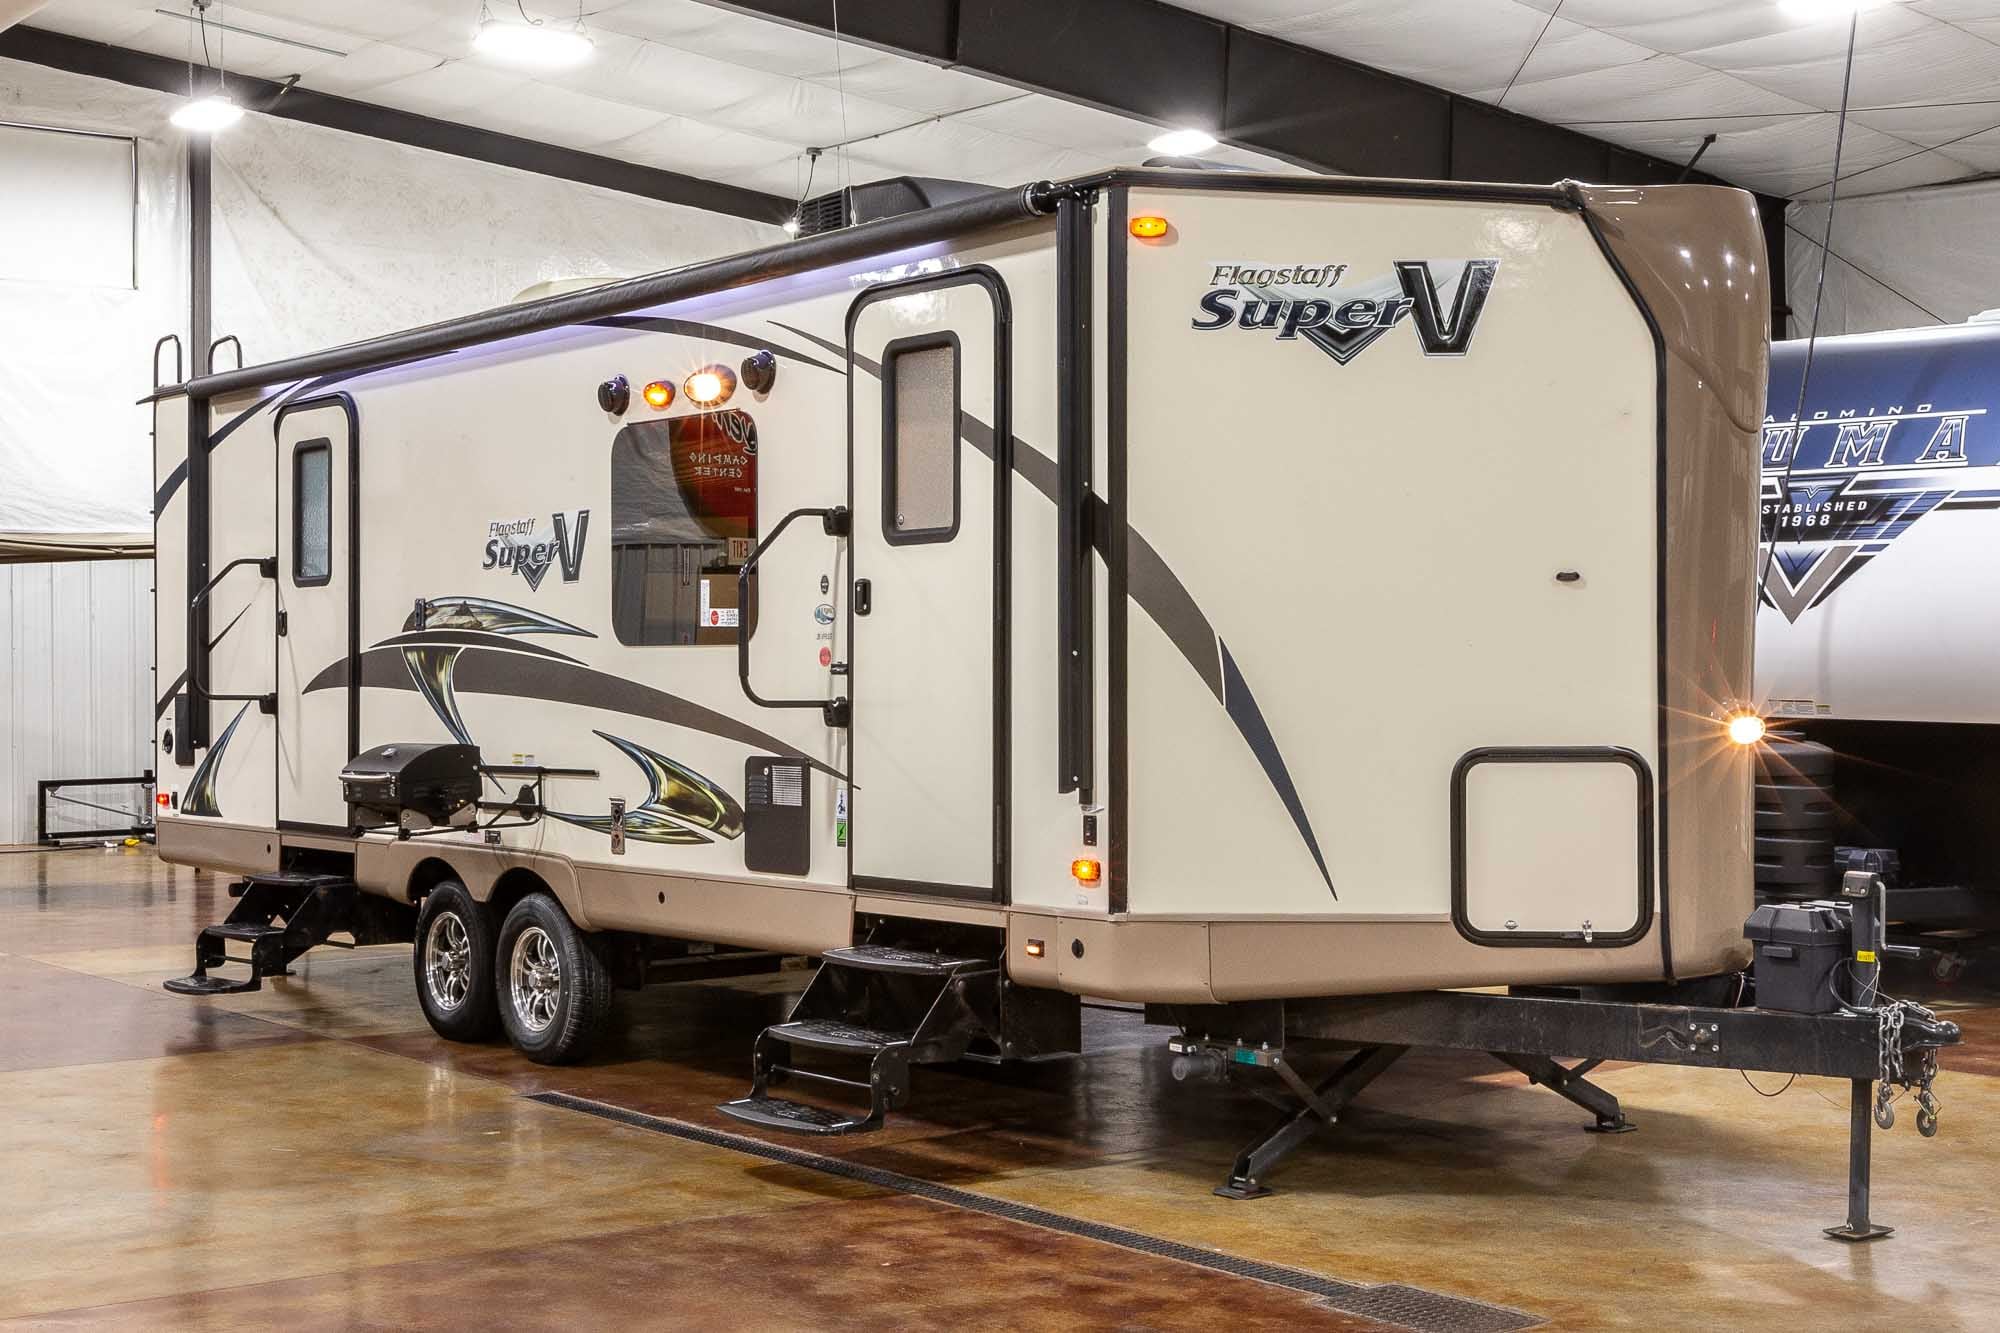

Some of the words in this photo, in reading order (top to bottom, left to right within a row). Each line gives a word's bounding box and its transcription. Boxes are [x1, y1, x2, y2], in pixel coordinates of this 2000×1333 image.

[1209, 264, 1349, 289] Flagstaff
[1191, 288, 1415, 341] Super
[1392, 257, 1502, 358] V
[1763, 404, 1932, 423] ALOMINO
[1762, 415, 1969, 472] UMA
[1762, 500, 1868, 514] STABLISHED
[488, 518, 536, 538] Flagstaff
[1781, 514, 1831, 527] 1968
[482, 538, 561, 576] Super
